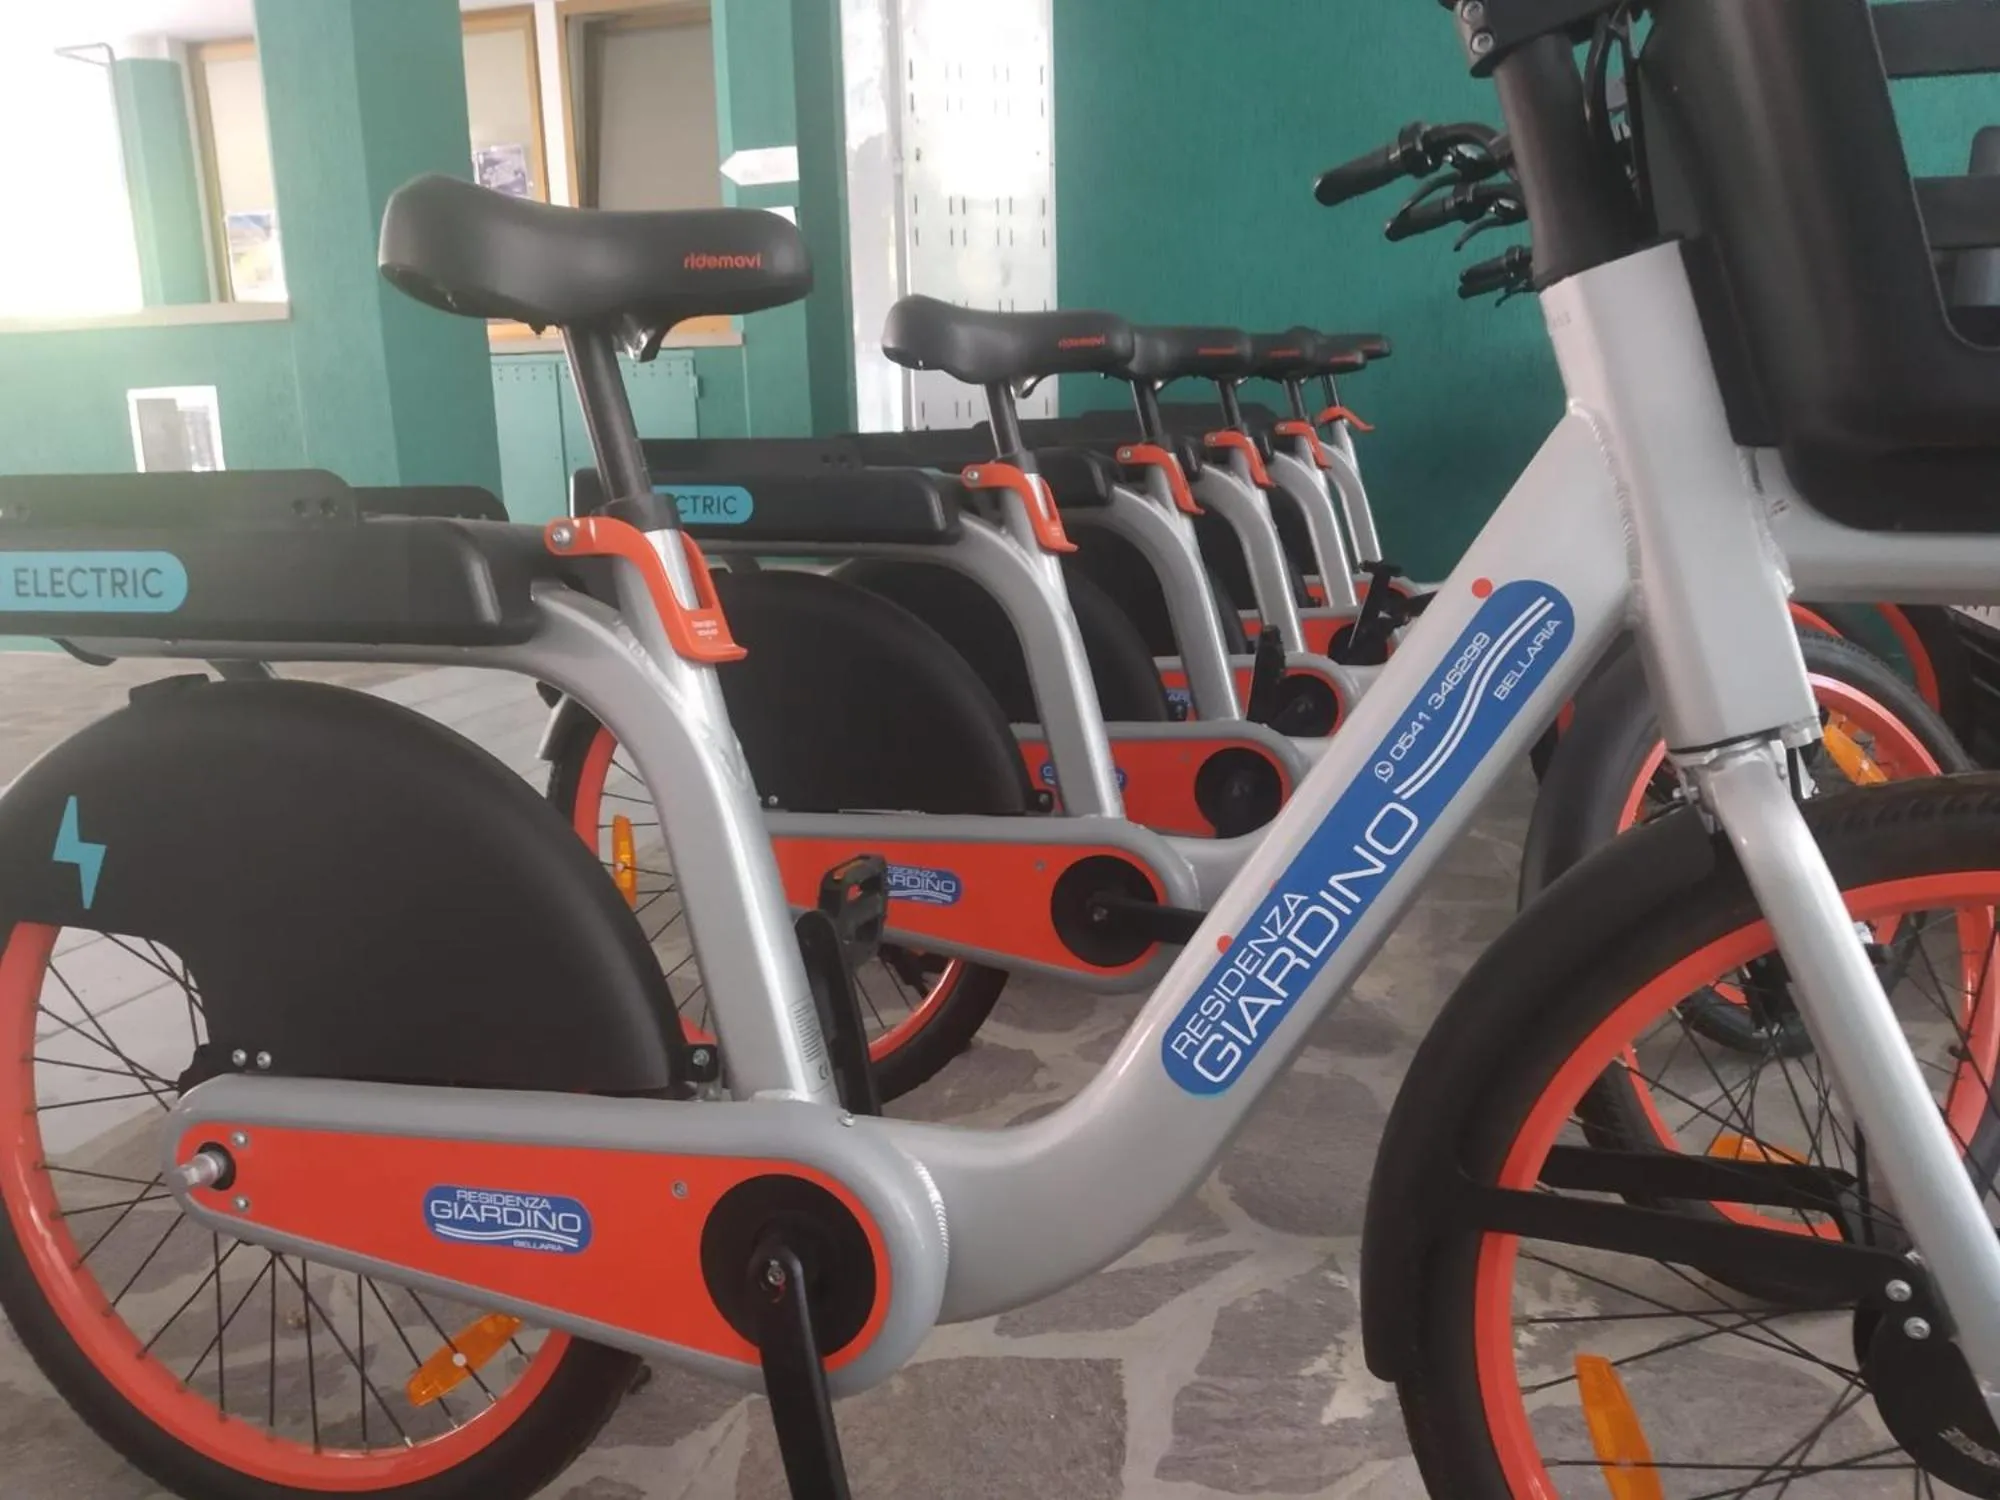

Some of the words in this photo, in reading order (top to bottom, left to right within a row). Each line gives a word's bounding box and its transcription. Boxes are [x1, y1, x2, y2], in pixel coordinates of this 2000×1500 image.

[683, 252, 763, 269] ridemovi
[676, 494, 738, 515] CTRIC
[12, 566, 165, 598] ELECTRIC
[1493, 618, 1564, 701] BELLARIA
[1390, 711, 1432, 761] 0541
[1427, 631, 1491, 711] 346299
[1192, 801, 1419, 1083] GIARDINO
[1170, 892, 1309, 1060] RESIDENZA
[430, 1199, 582, 1233] GIARDINO
[455, 1189, 552, 1210] RESIDENZA
